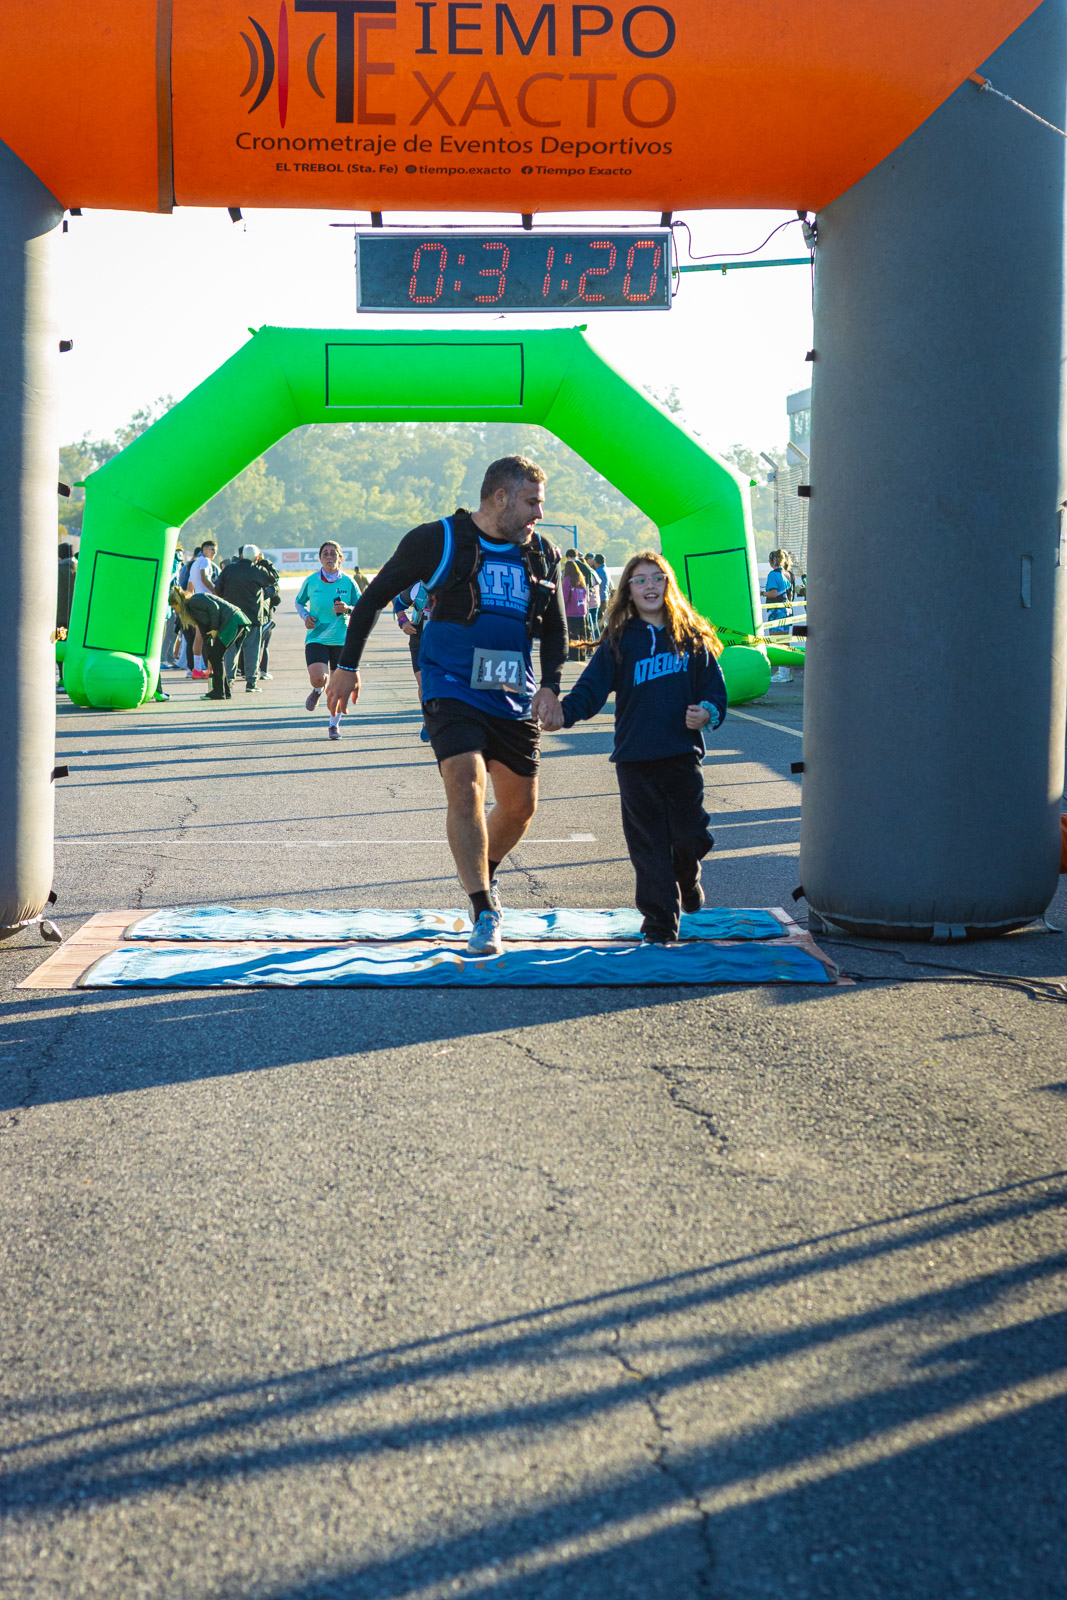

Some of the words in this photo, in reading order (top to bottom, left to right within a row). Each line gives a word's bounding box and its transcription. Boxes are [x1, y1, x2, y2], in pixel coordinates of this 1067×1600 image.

[235, 132, 397, 156] Cronometraje
[403, 134, 433, 153] de
[440, 135, 533, 153] Eventos
[541, 136, 673, 158] Deportivos
[275, 162, 291, 172] EL
[293, 163, 344, 173] TREBOL
[347, 163, 376, 174] (Sta.
[379, 164, 398, 174] Fe)
[535, 165, 586, 176] Tiempo
[589, 166, 632, 175] Exacto
[483, 659, 518, 683] 147
